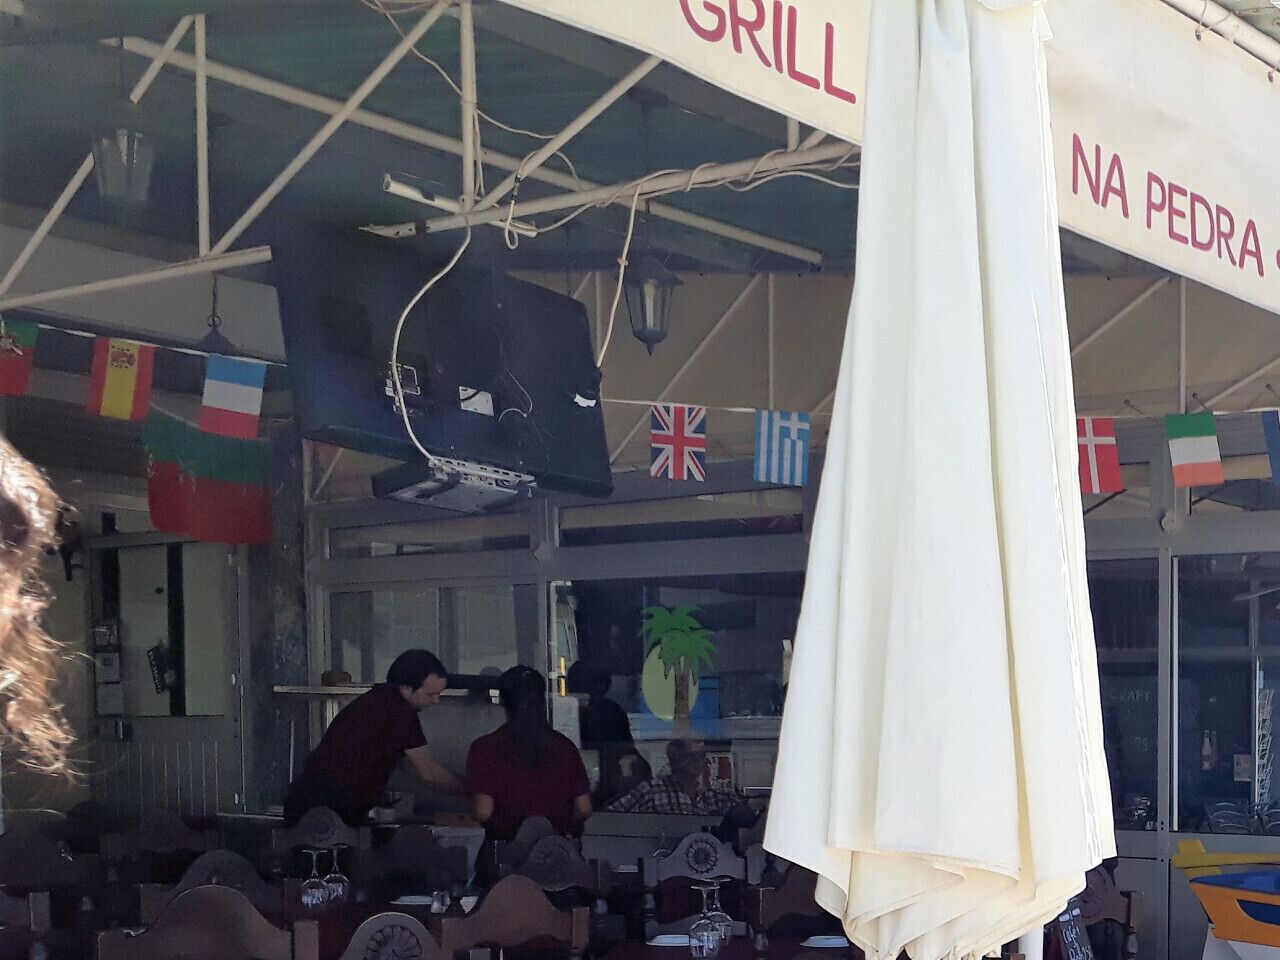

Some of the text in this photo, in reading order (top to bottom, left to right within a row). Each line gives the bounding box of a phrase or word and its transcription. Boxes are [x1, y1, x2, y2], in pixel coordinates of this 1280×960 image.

[679, 0, 857, 104] GRILL
[1072, 133, 1129, 219] NA
[1146, 170, 1265, 278] PEDRA
